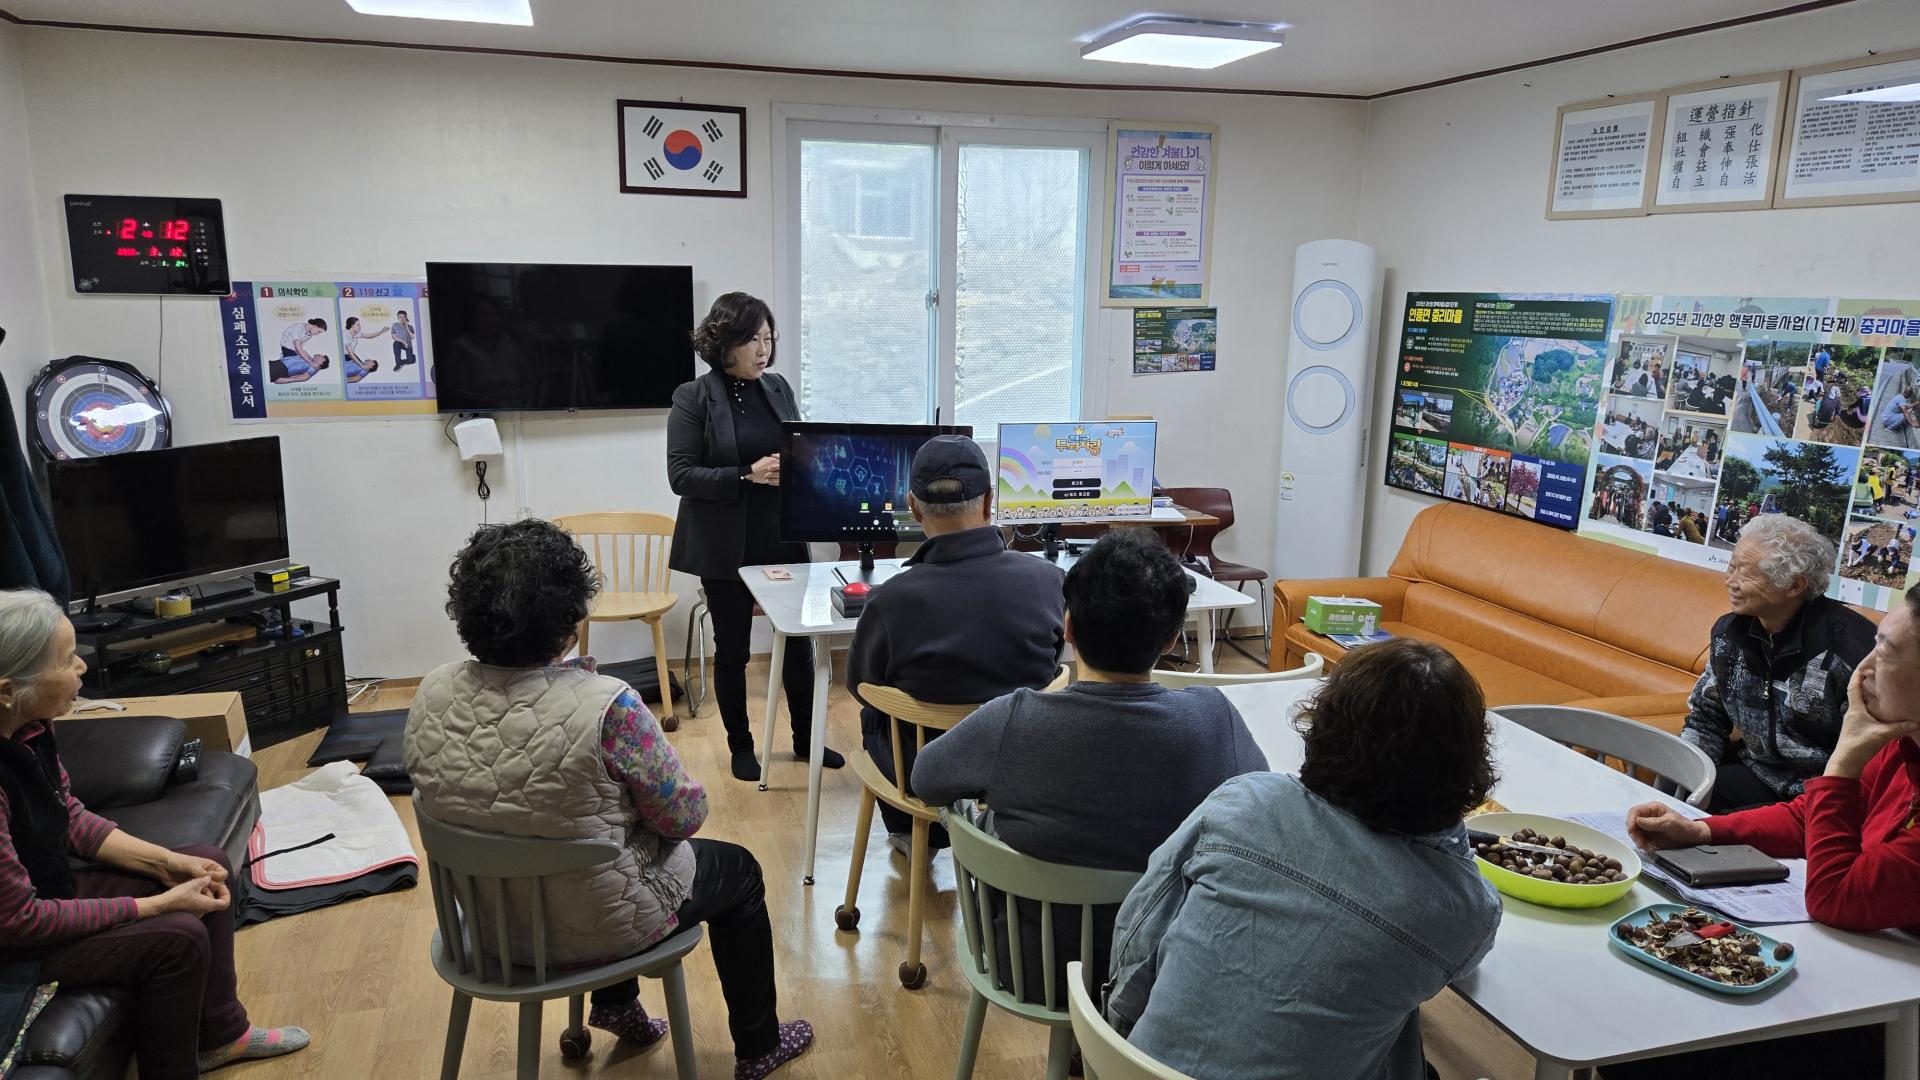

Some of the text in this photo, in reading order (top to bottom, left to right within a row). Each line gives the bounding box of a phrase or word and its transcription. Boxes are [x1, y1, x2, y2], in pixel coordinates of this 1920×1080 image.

[1131, 145, 1200, 160] 건강한 겨울나기
[1139, 160, 1190, 171] 이렇게 하세요!
[263, 288, 269, 297] 1
[278, 288, 308, 297] 의식확인
[345, 288, 352, 297] 2
[359, 288, 390, 297] 119 신고
[1431, 308, 1463, 324] 중리마을
[1644, 312, 1920, 336] 2025년 괴산형 행복마을사업(1단계) 중리마을
[232, 307, 254, 408] 심폐소생술 순서
